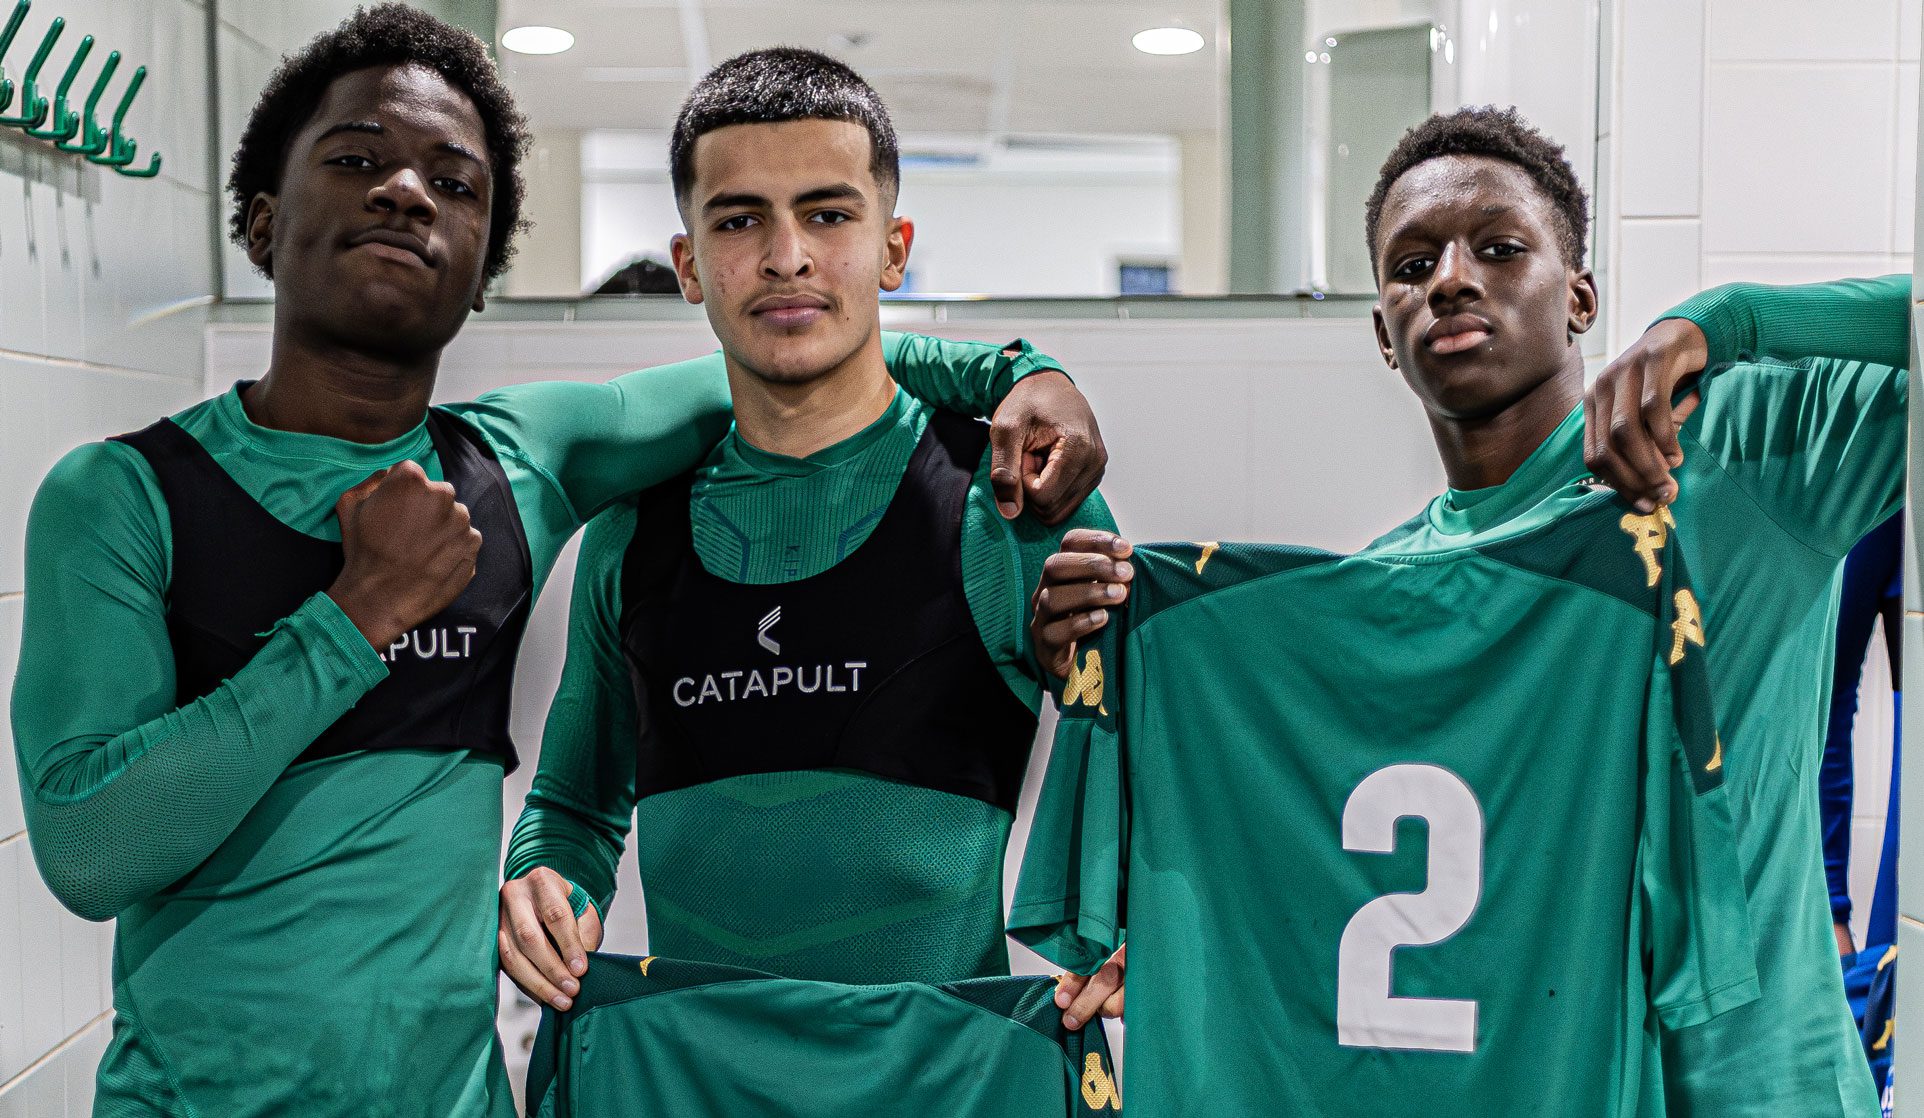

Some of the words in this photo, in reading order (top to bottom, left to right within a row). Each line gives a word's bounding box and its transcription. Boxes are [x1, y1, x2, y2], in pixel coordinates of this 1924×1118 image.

[380, 626, 477, 662] PULT
[672, 661, 867, 707] CATAPULT
[1337, 763, 1484, 1052] 2
